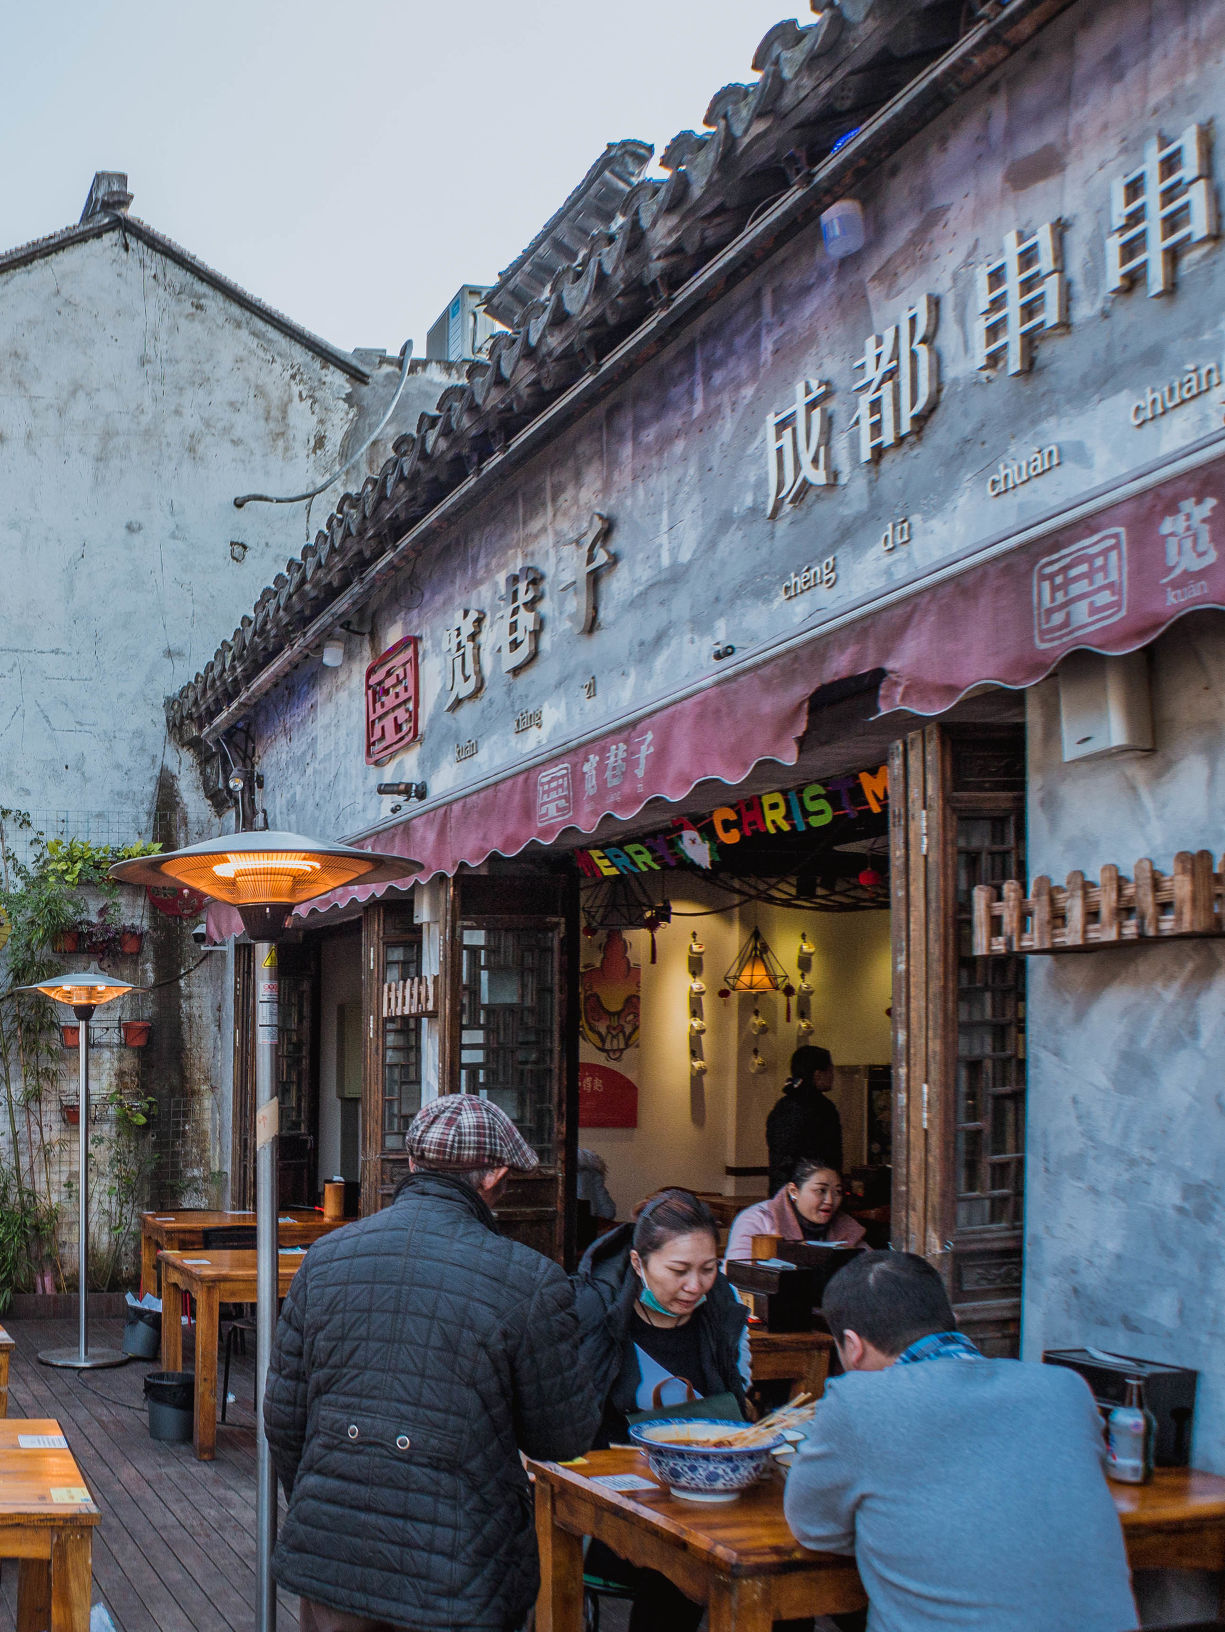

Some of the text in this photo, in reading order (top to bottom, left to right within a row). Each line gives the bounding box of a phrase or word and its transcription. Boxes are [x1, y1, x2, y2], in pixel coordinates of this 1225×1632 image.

[765, 119, 1217, 520] 成都串串
[782, 555, 836, 600] chéng
[882, 517, 911, 552] dū
[1130, 362, 1222, 427] chuān
[444, 513, 617, 713] 宽巷子
[576, 835, 676, 878] MERRY
